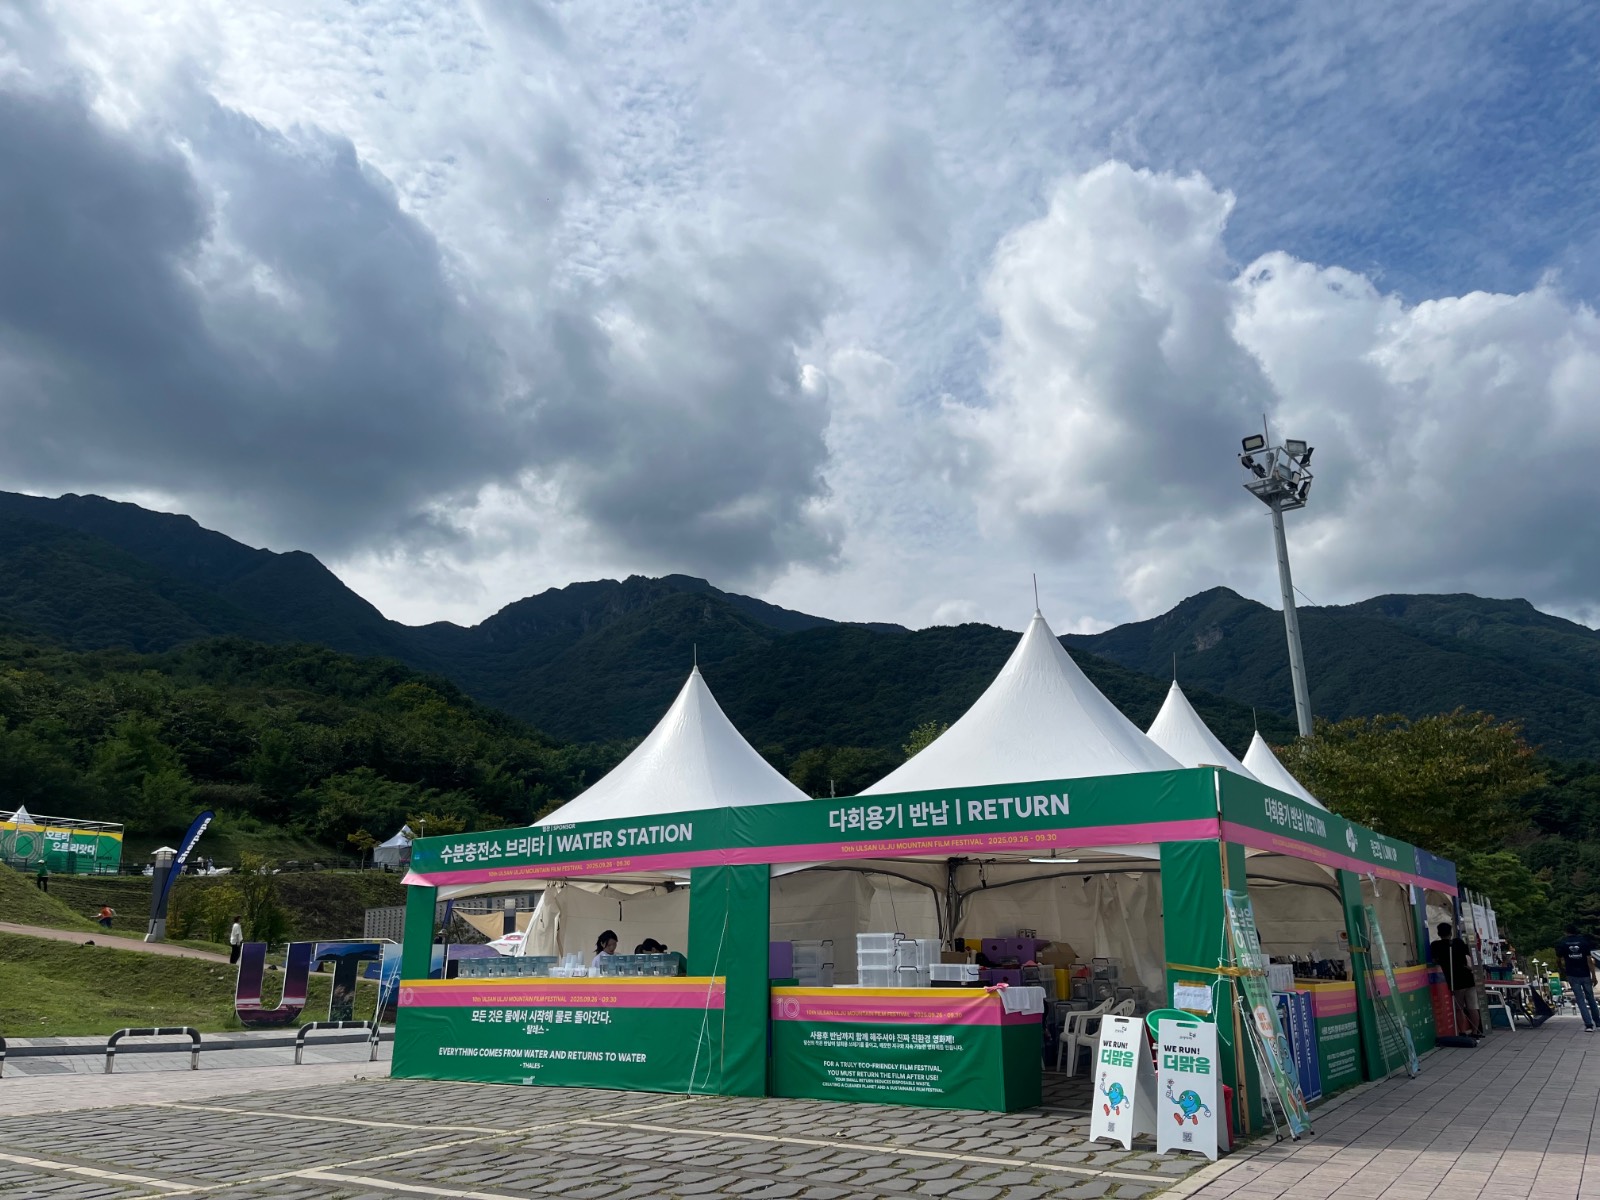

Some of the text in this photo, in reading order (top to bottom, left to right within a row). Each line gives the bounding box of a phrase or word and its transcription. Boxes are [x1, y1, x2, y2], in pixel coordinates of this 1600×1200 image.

[829, 804, 903, 832] 다회용기
[909, 800, 949, 826] 반납
[968, 794, 1070, 821] RETURN
[1264, 797, 1291, 828] 다회용기
[1290, 806, 1303, 831] 반납
[45, 830, 71, 842] 오르리
[177, 817, 212, 864] Sherpapa
[440, 841, 502, 864] 수분충전소
[505, 836, 545, 858] 브리타
[556, 830, 613, 852] WATER
[616, 822, 692, 847] STATION
[896, 842, 933, 850] MOUNTAIN
[988, 836, 1028, 845] 2025.09.26
[471, 1010, 612, 1024] 모든 것은 물에서 시작해 물로 돌아간다.
[776, 997, 800, 1018] 10
[810, 1031, 828, 1040] 사용후
[830, 1032, 854, 1041] 반납까지
[856, 1032, 868, 1041] 함께
[897, 1034, 909, 1042] 진짜
[911, 1034, 930, 1043] 친환경
[439, 1047, 646, 1062] EVERYTHING COMES FROM WATER AND RETURNS TO WATER
[1100, 1049, 1134, 1068] 더맑음
[1179, 1045, 1200, 1055] RUN!
[1164, 1055, 1210, 1074] 더맑음
